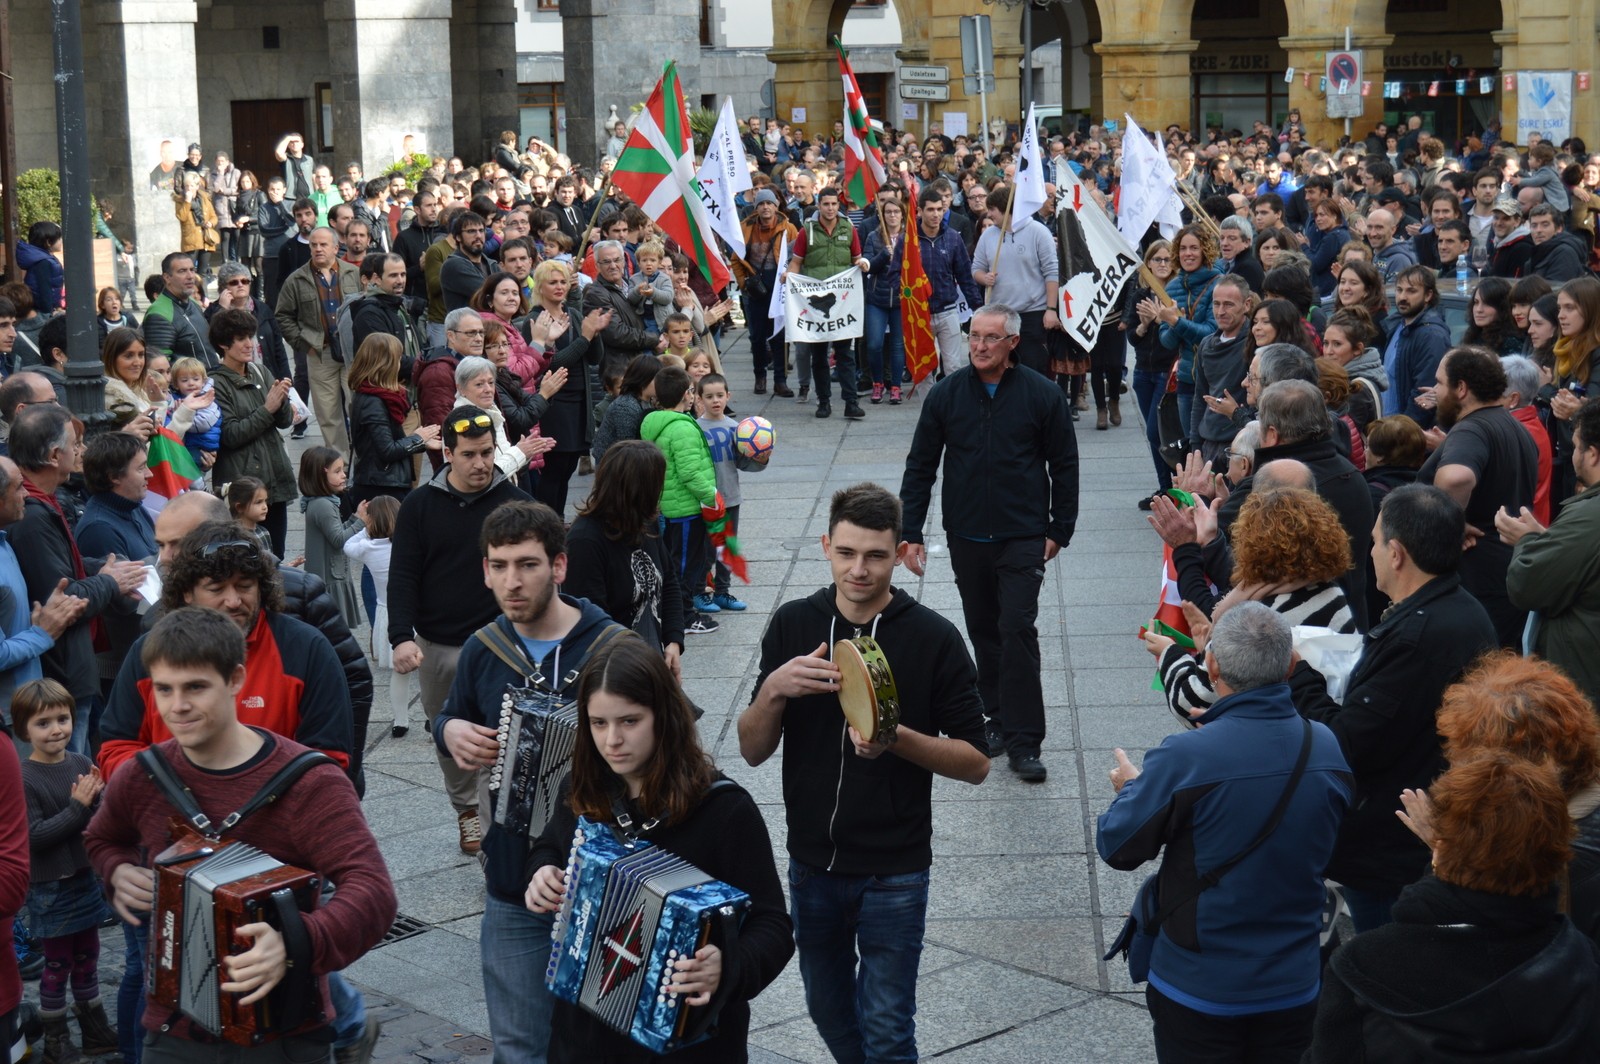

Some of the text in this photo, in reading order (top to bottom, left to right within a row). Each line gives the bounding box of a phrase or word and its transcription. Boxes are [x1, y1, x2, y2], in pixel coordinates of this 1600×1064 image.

[789, 287, 805, 295] ETA
[806, 283, 855, 293] IHESLARIAK
[791, 281, 824, 289] EUSKAL
[1076, 251, 1137, 344] ETXERA
[796, 313, 857, 333] ETXERA
